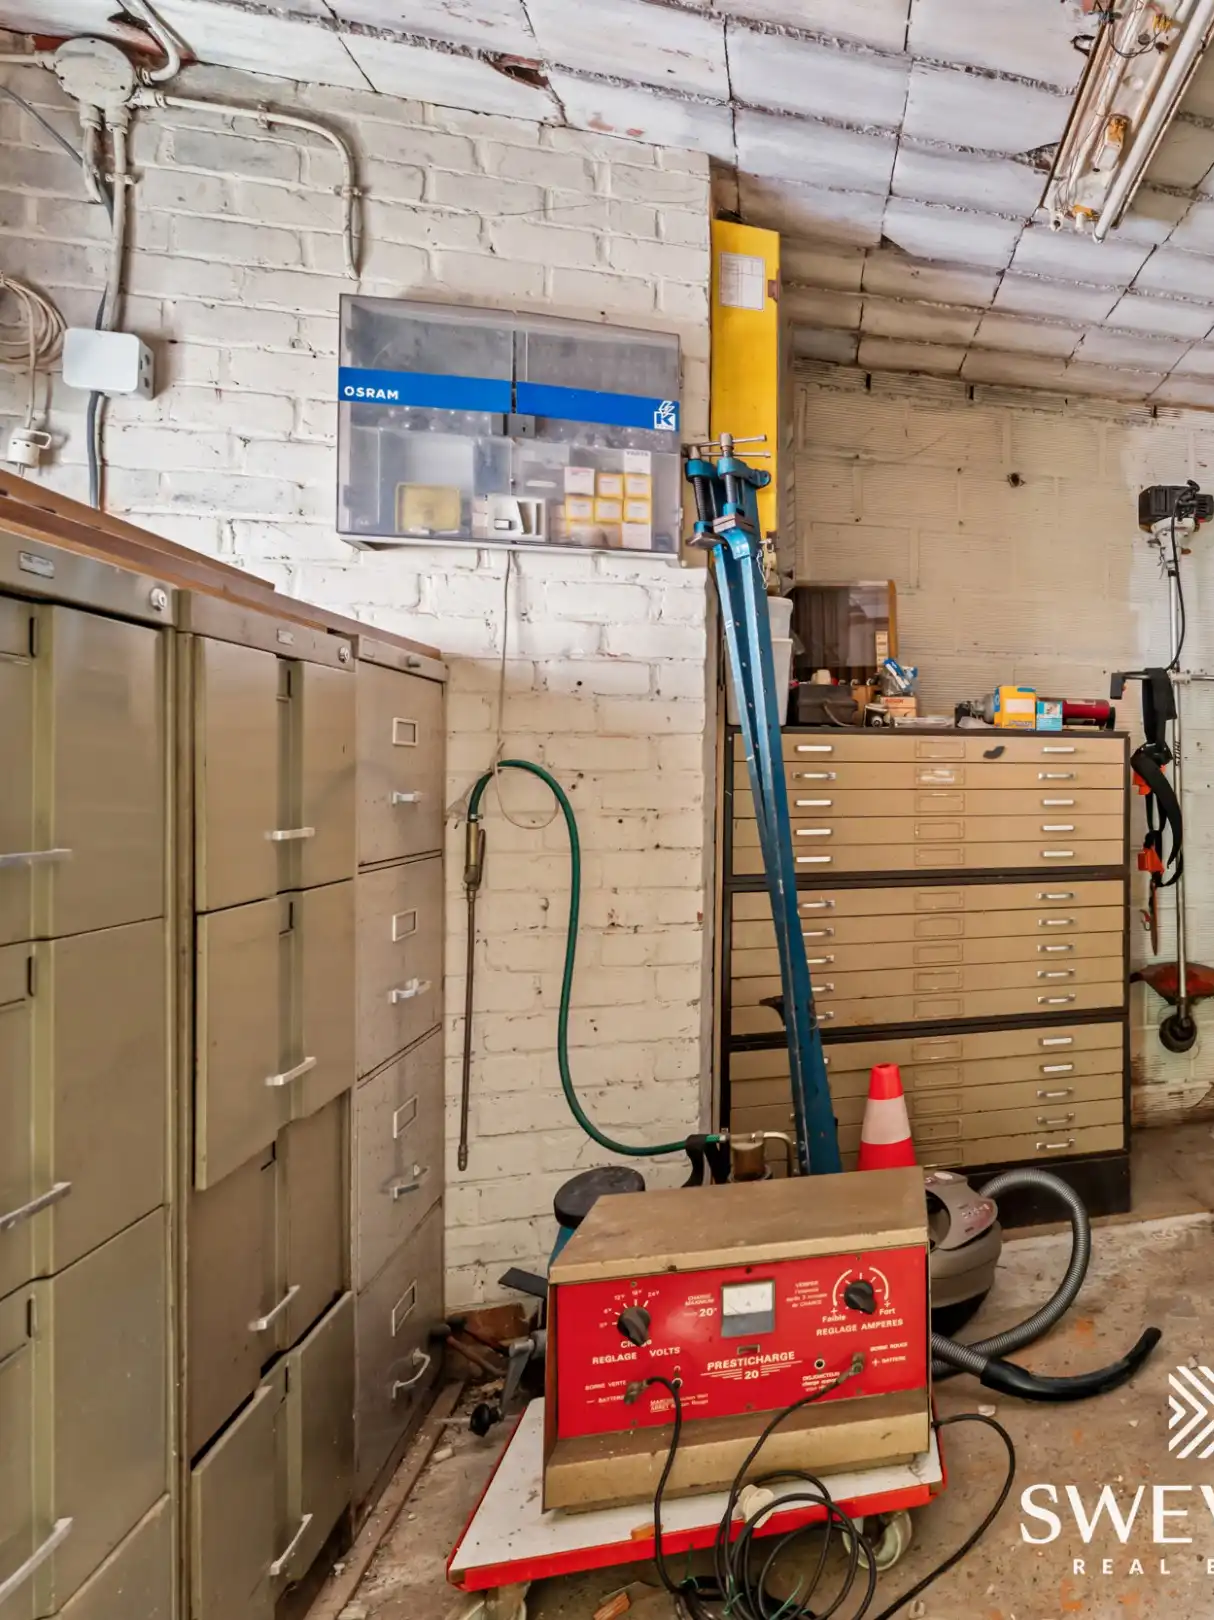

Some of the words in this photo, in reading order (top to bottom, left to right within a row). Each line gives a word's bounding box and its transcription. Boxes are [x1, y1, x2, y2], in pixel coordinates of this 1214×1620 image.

[344, 385, 399, 400] OSRAM
[822, 1314, 847, 1323] Faible
[879, 1307, 896, 1315] Fort
[816, 1323, 858, 1337] REGLAGE
[861, 1318, 904, 1331] AMPERES
[592, 1351, 637, 1365] REGLAGE
[649, 1346, 680, 1358] VOLTS
[707, 1351, 796, 1372] PRESTICHARGE
[744, 1370, 759, 1380] 20
